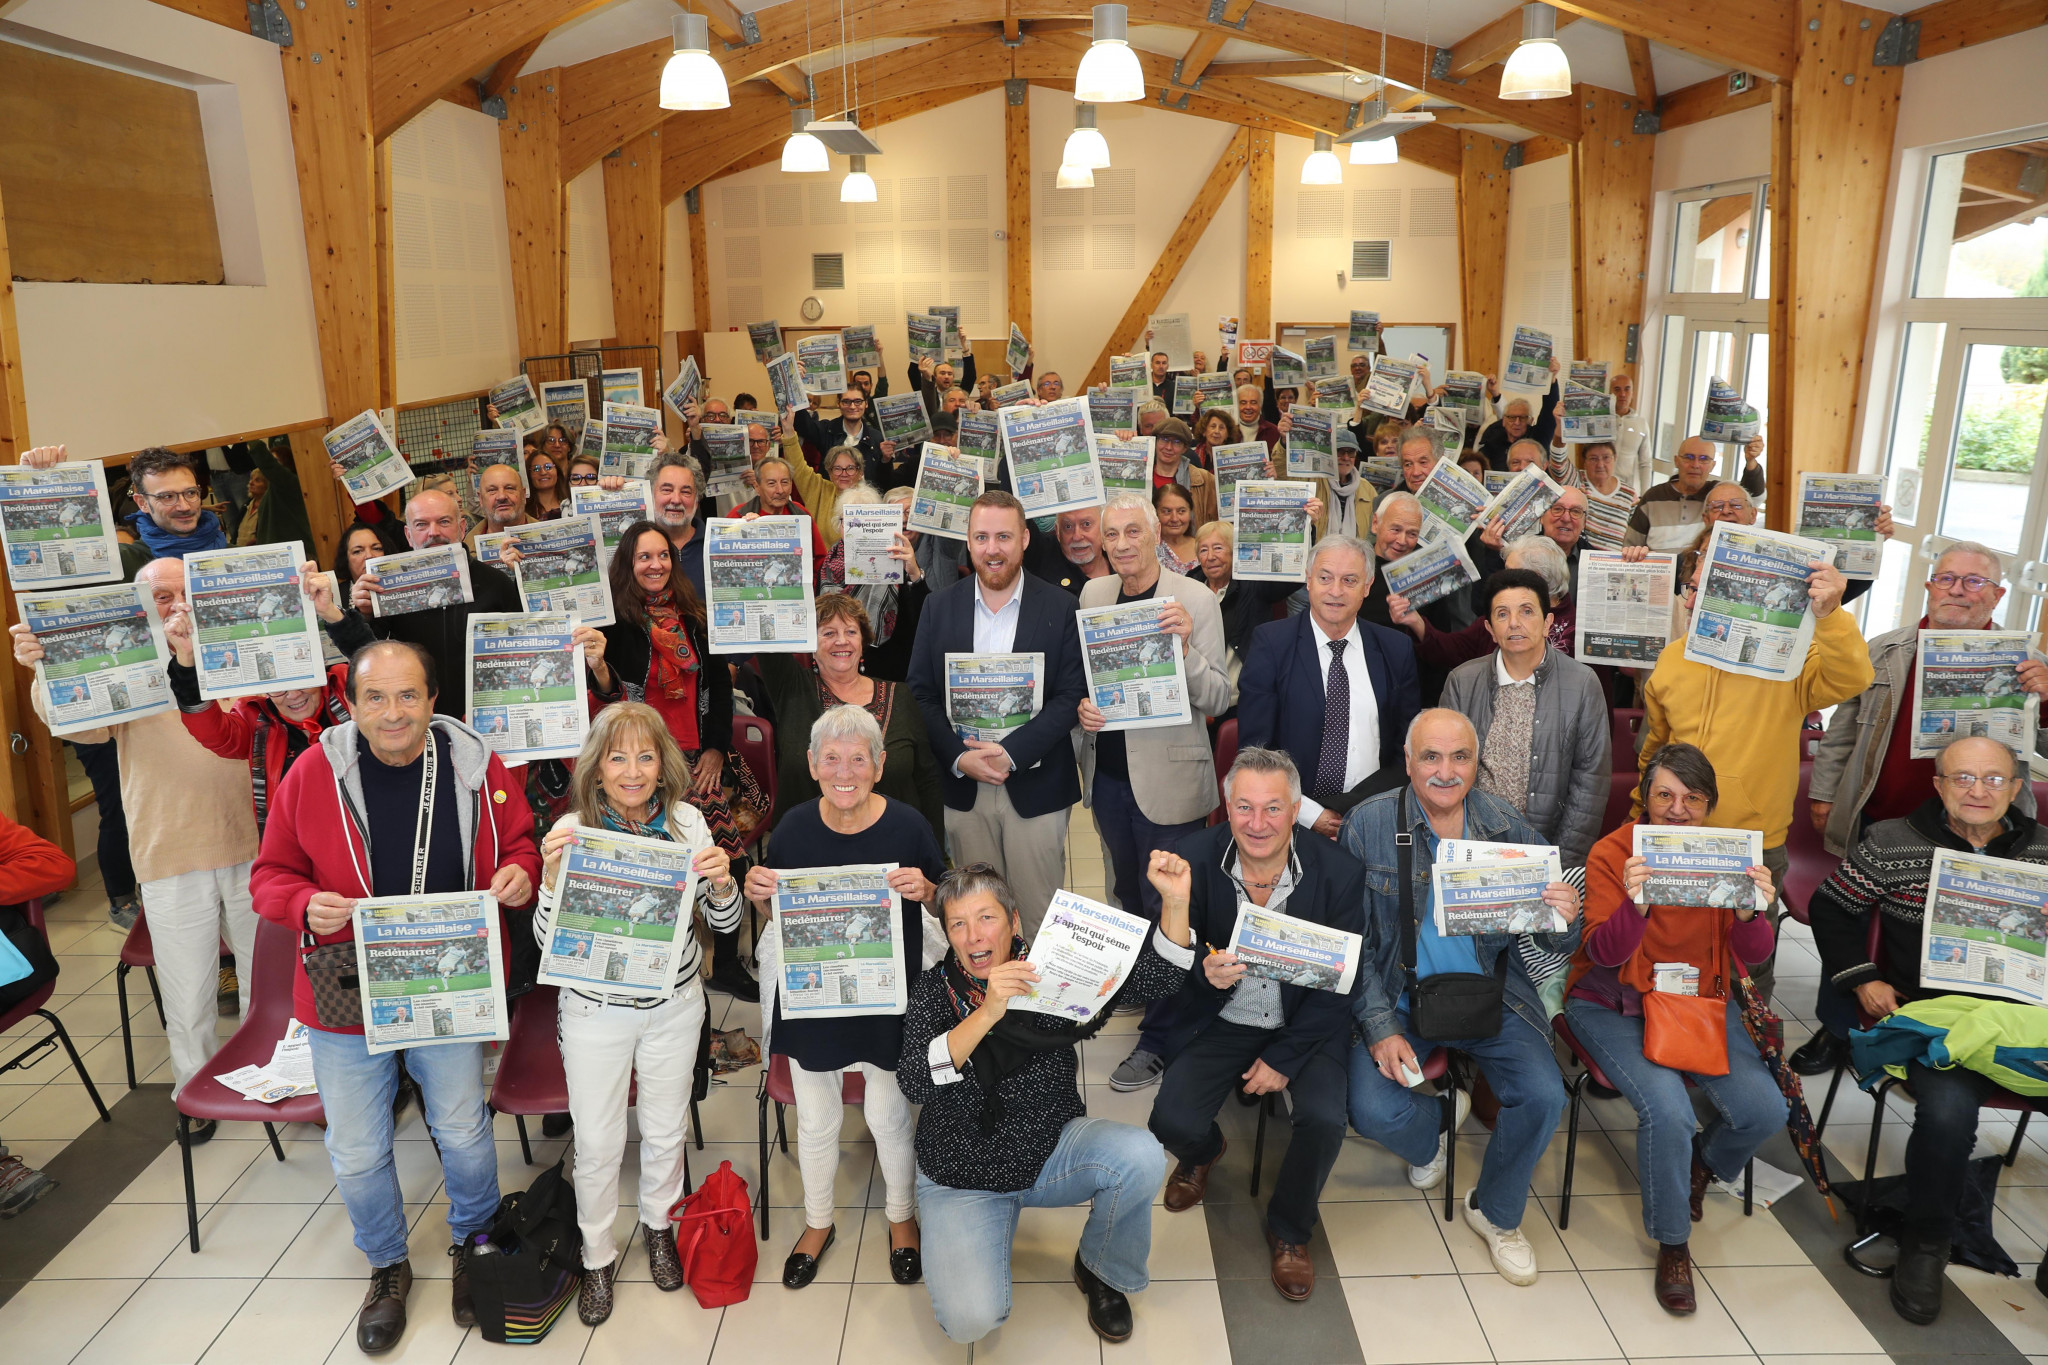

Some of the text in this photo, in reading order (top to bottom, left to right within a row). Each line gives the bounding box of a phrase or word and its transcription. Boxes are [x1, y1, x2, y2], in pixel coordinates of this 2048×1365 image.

[1026, 416, 1074, 431] Marseillaise
[8, 484, 85, 496] La Marseillaise
[1824, 493, 1873, 501] Marseillaise
[4, 503, 58, 513] Redémarrer
[594, 501, 637, 510] Marseillaise
[522, 537, 585, 551] La Marseillaise
[719, 541, 790, 550] La Marseillaise
[713, 560, 764, 568] Redémarrer
[1725, 551, 1806, 576] La Marseillaise
[201, 571, 285, 588] La Marseillaise
[383, 568, 448, 586] La Marseillaise
[1712, 568, 1770, 587] Redémarrer
[196, 595, 256, 608] Redémarrer
[380, 588, 427, 602] Redémarrer
[41, 609, 131, 628] La Marseillaise
[38, 627, 103, 645] Redémarrer
[1094, 631, 1105, 639] La
[484, 638, 560, 649] La Marseillaise
[1090, 642, 1138, 656] Redémarrer
[476, 660, 531, 669] Redémarrer
[1936, 653, 2019, 662] La Marseillaise
[958, 675, 1025, 683] La Marseillaise
[952, 692, 1000, 700] Redémarrer
[423, 756, 434, 813] JEAN-LOUIS
[1655, 855, 1742, 868] La Marseillaise
[582, 857, 673, 882] La Marseillaise
[568, 879, 634, 897] Redémarrer
[1647, 876, 1710, 887] Redémarrer
[1454, 886, 1538, 900] La Marseillaise
[1950, 877, 2041, 902] La Marseillaise
[791, 892, 877, 905] La Marseillaise
[1938, 895, 2001, 913] Redémarrer
[784, 914, 845, 926] Redémarrer
[1054, 896, 1144, 937] La Marseillaise
[1447, 910, 1508, 920] Redémarrer
[377, 923, 473, 937] La Marseillaise
[1053, 914, 1131, 952] L'appel qui sème
[1071, 931, 1106, 952] l'espoir
[1250, 934, 1333, 962] La Marseillaise
[369, 947, 437, 958] Redémarrer
[1237, 952, 1297, 972] Redémarrer
